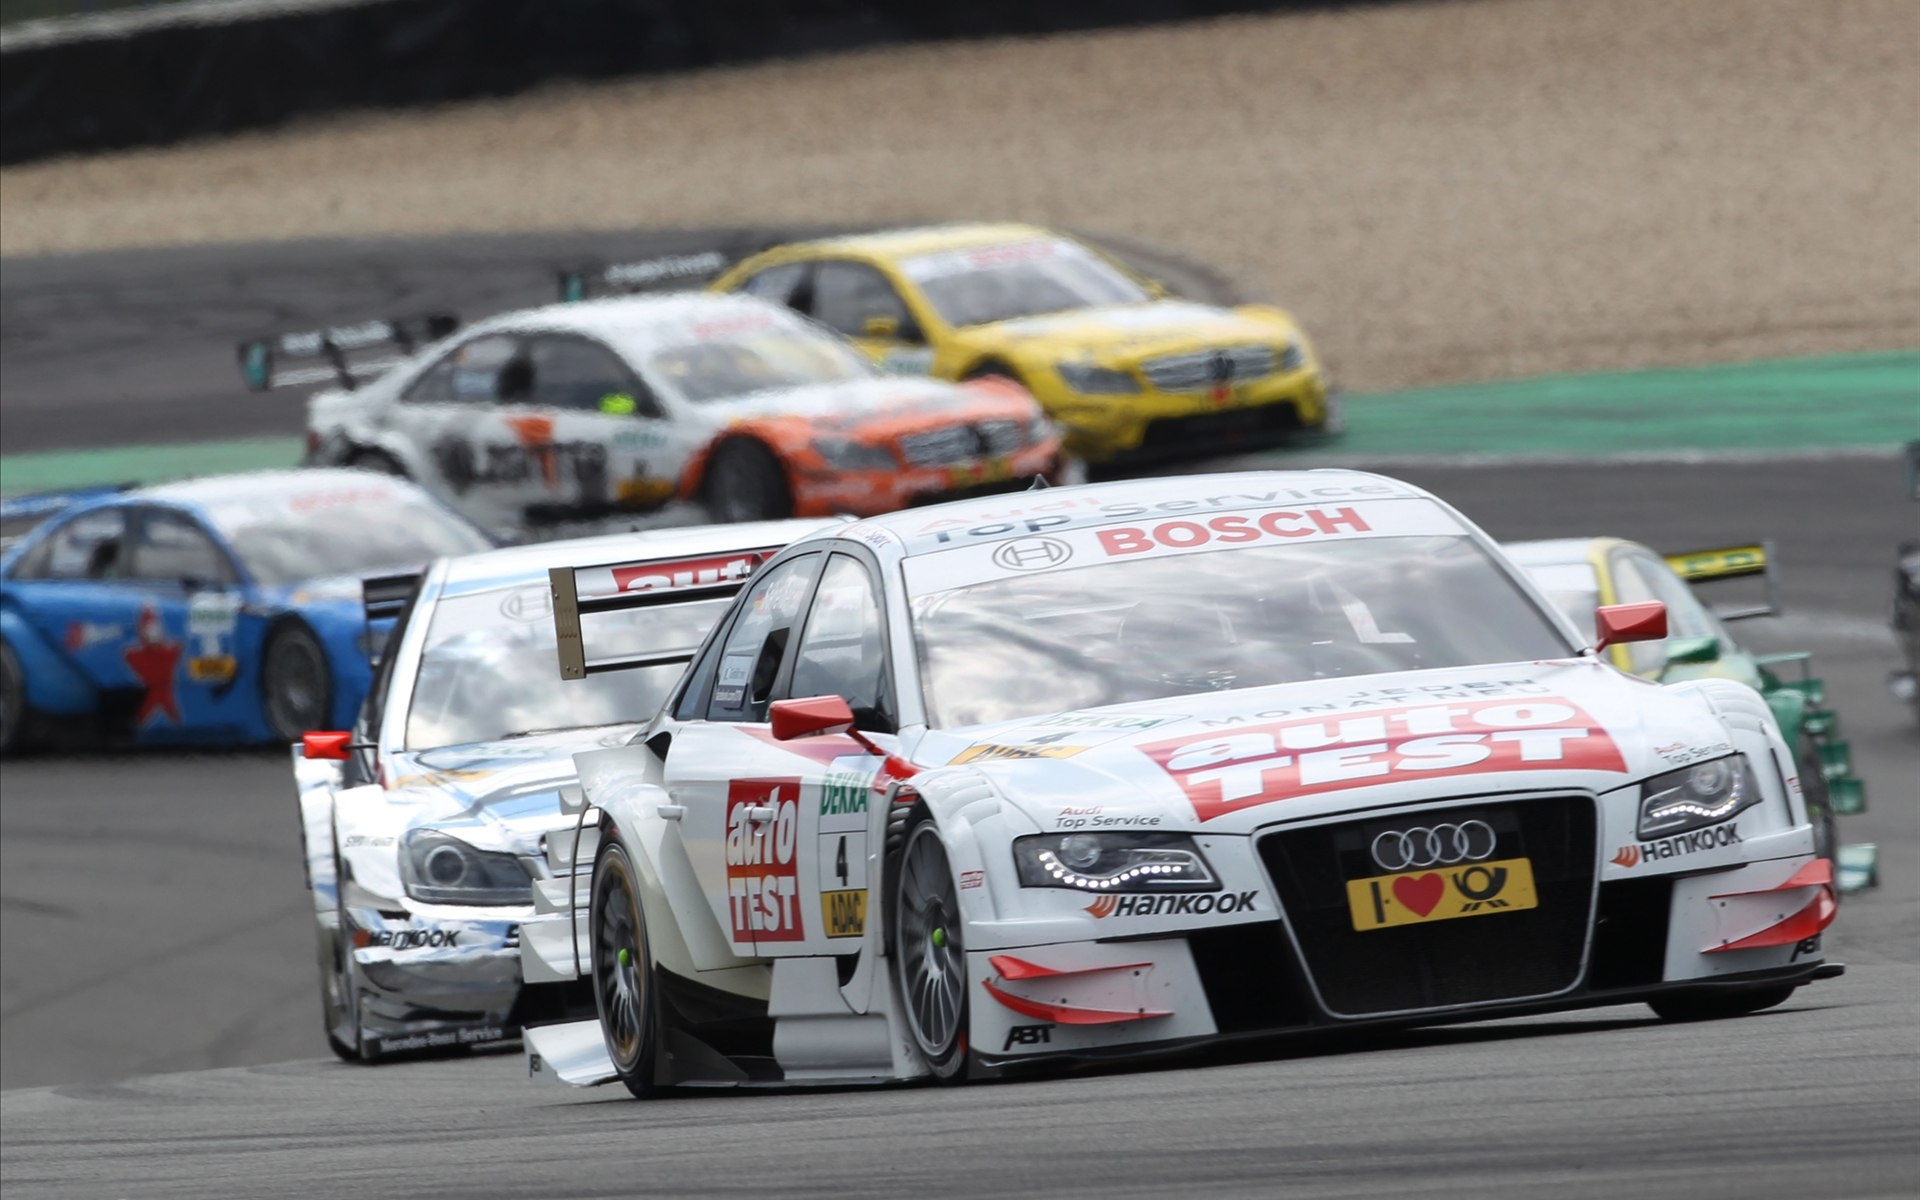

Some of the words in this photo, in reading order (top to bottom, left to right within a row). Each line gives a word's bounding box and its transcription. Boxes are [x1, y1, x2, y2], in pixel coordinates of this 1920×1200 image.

[917, 496, 1101, 537] Audi
[918, 514, 1071, 544] Top
[1099, 483, 1396, 519] Service
[1095, 507, 1372, 557] BOSCH
[1200, 694, 1409, 727] MONAT
[1433, 685, 1552, 700] NEU
[1347, 679, 1537, 699] JEDEN
[1166, 703, 1577, 772] auto
[1662, 751, 1690, 766] Top
[1690, 742, 1732, 757] Service
[1187, 727, 1589, 803] TEST
[819, 772, 873, 816] DEKRA
[1059, 806, 1105, 816] Audi
[727, 785, 797, 867] auto
[1055, 816, 1086, 829] Top
[1090, 814, 1161, 827] Service
[835, 835, 849, 887] 4
[729, 875, 796, 932] TEST
[830, 892, 864, 934] ADAC
[1003, 1024, 1056, 1051] ABT
